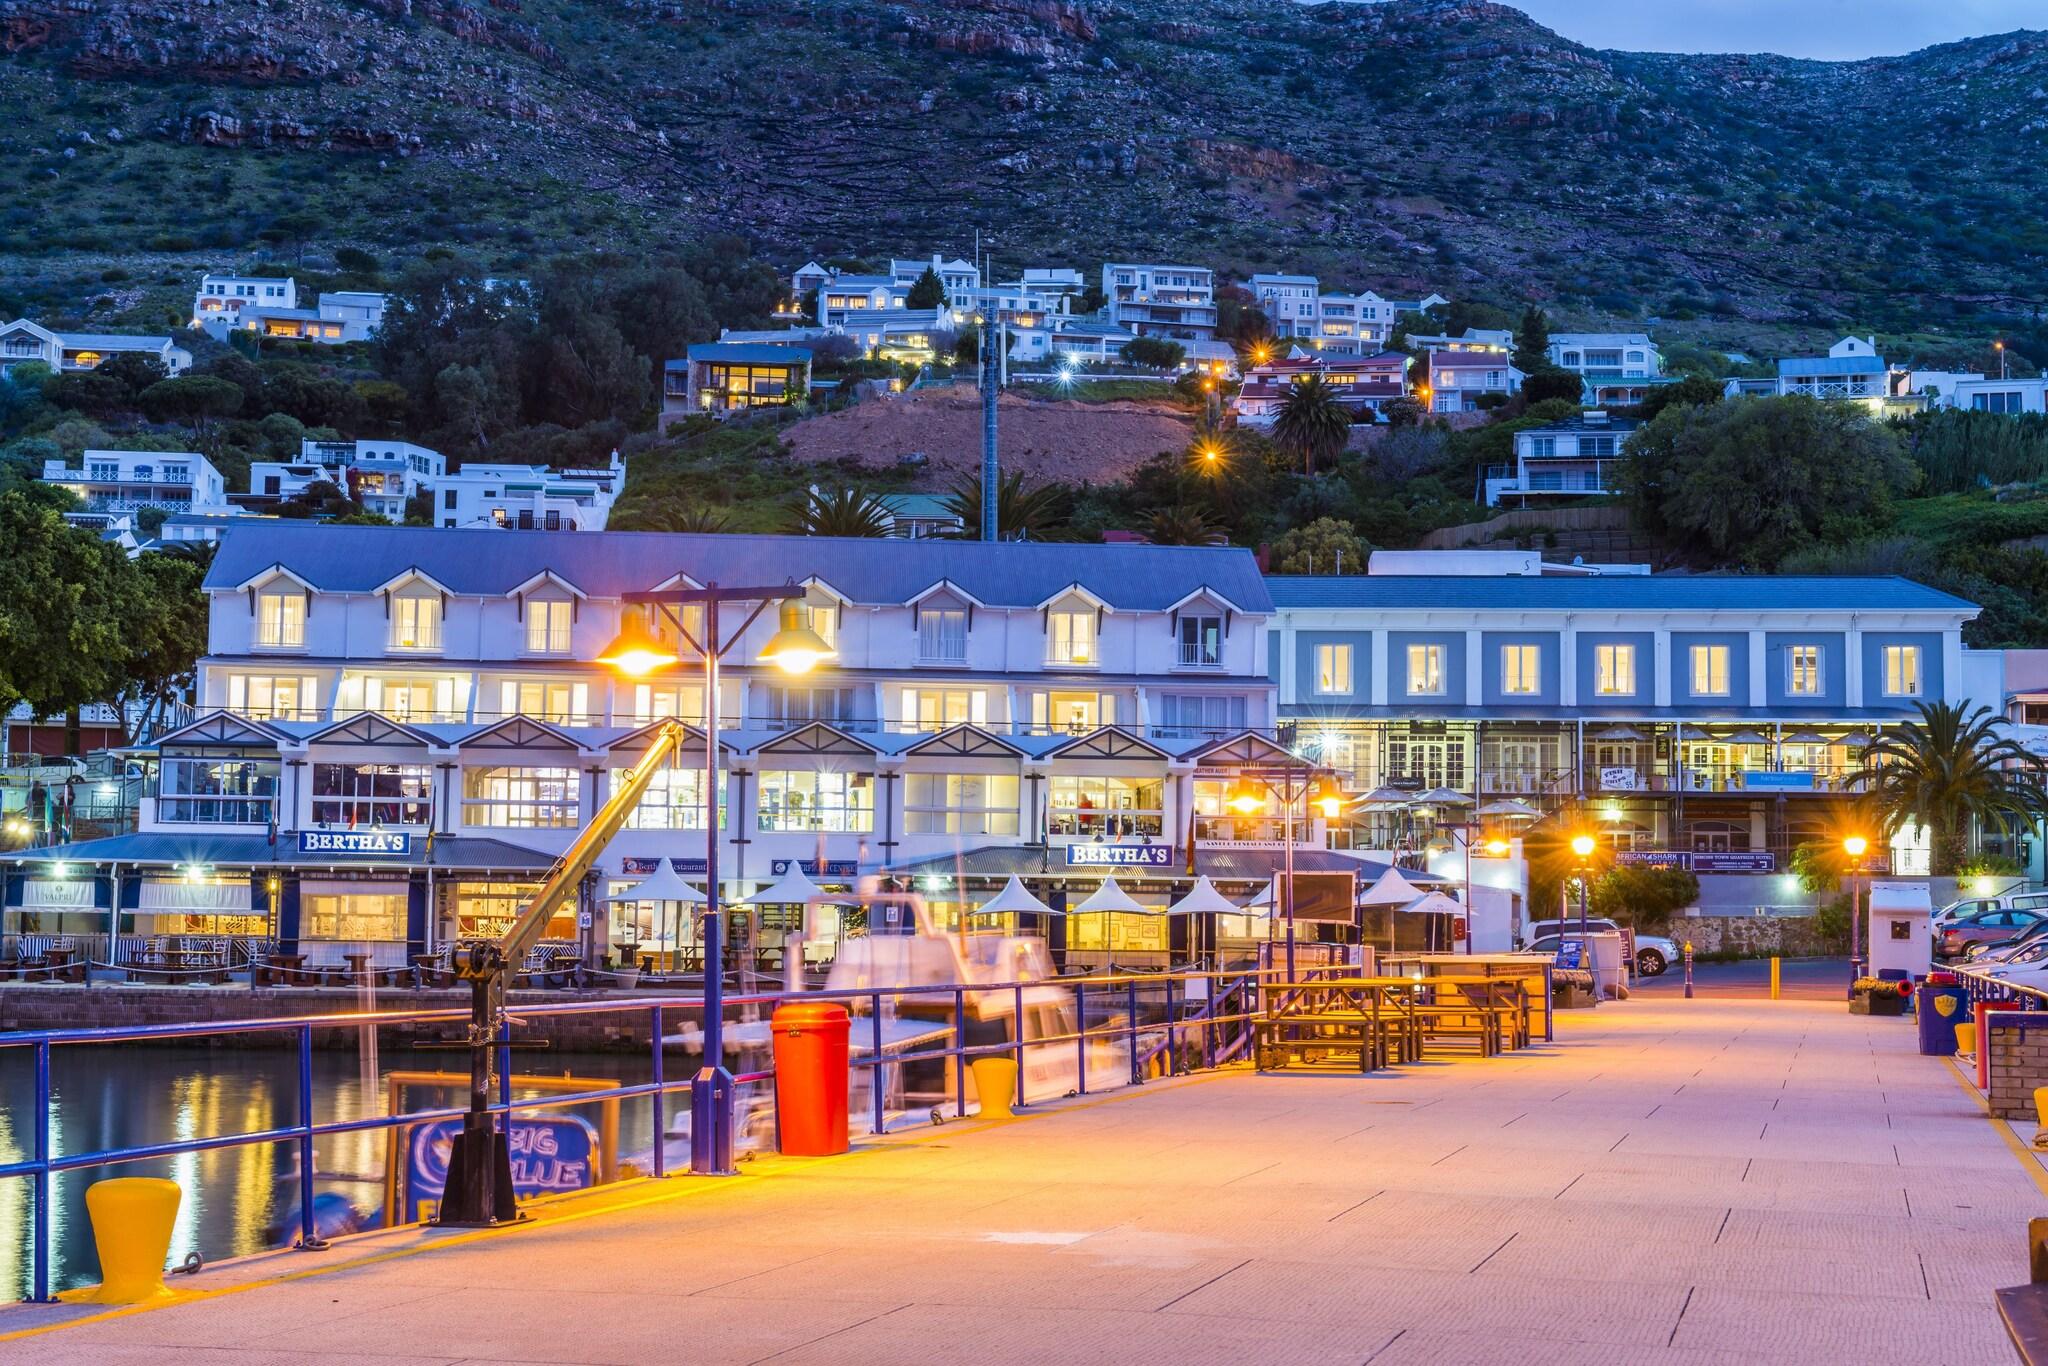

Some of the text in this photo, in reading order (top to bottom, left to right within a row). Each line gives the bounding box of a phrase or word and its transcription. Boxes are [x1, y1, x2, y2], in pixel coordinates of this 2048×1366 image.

[1604, 769, 1623, 778] FISH
[304, 832, 404, 851] BERTHA'S
[1072, 846, 1168, 863] BERTHA'S
[1616, 853, 1678, 861] AFRICAN SHARK
[672, 863, 707, 871] estaurant
